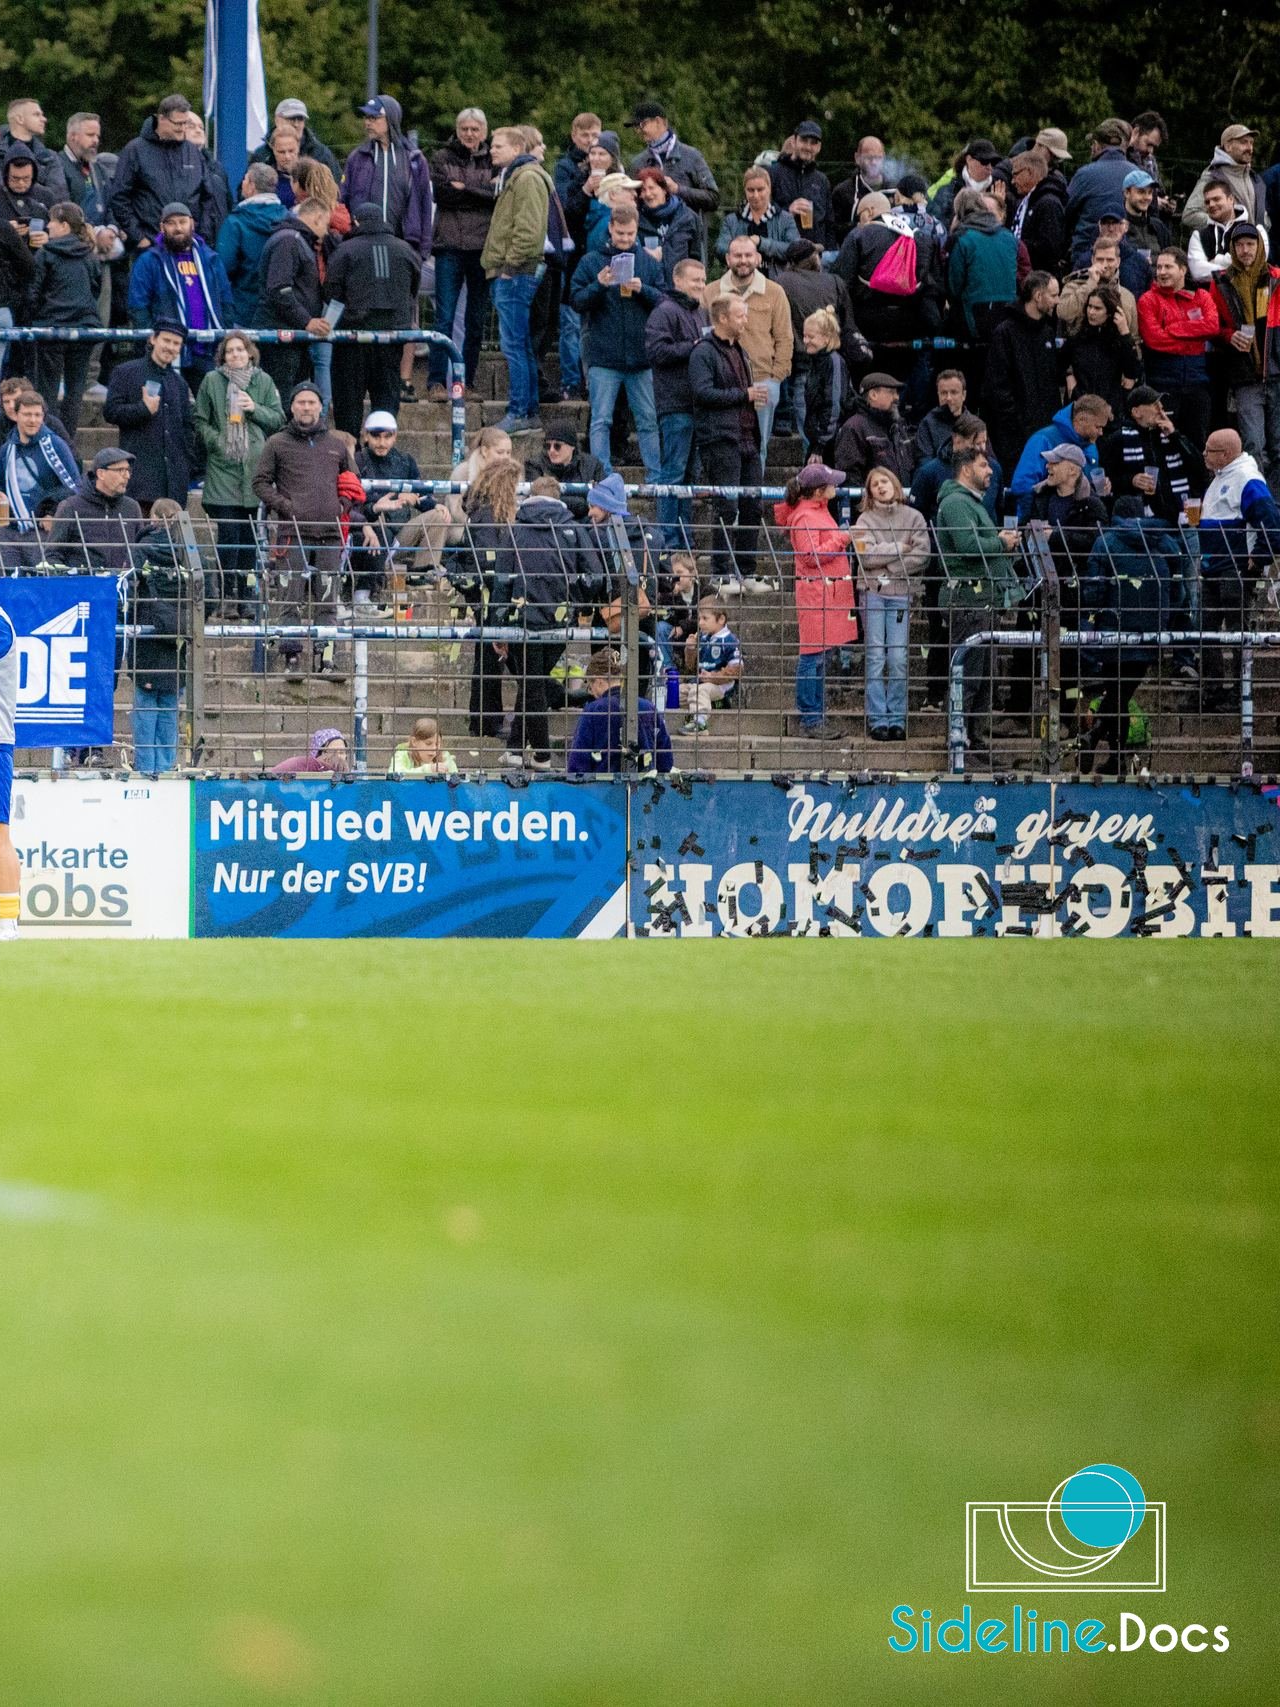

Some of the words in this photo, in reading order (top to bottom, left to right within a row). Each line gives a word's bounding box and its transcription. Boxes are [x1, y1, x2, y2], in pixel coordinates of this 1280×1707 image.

[210, 800, 393, 851] Mitglied
[405, 801, 589, 842] werden.
[212, 862, 274, 893] Nur
[282, 862, 339, 893] der
[346, 862, 428, 893] SVB!
